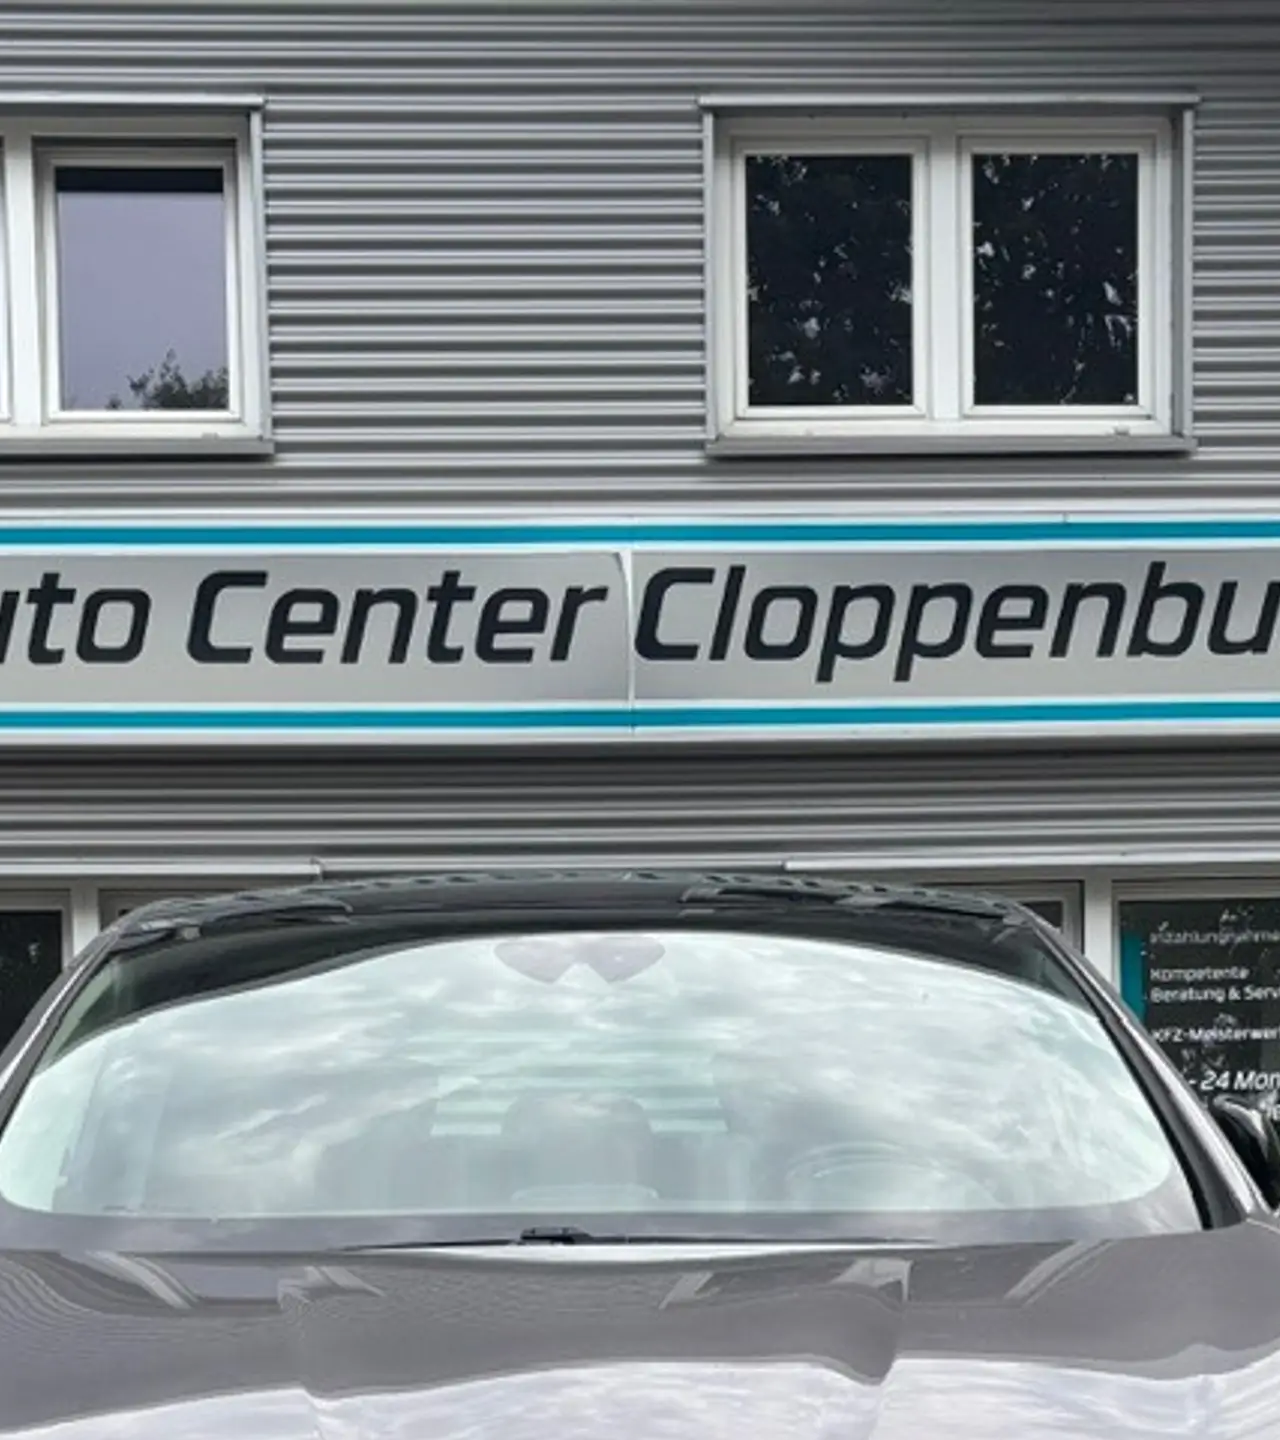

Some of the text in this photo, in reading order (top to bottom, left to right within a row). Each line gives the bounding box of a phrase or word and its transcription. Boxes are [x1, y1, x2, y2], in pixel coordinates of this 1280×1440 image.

[185, 569, 608, 664] Center
[1150, 966, 1250, 981] Kompetente
[1150, 987, 1225, 1003] Beratung
[1228, 987, 1241, 1000] &
[1200, 1071, 1230, 1090] 24
